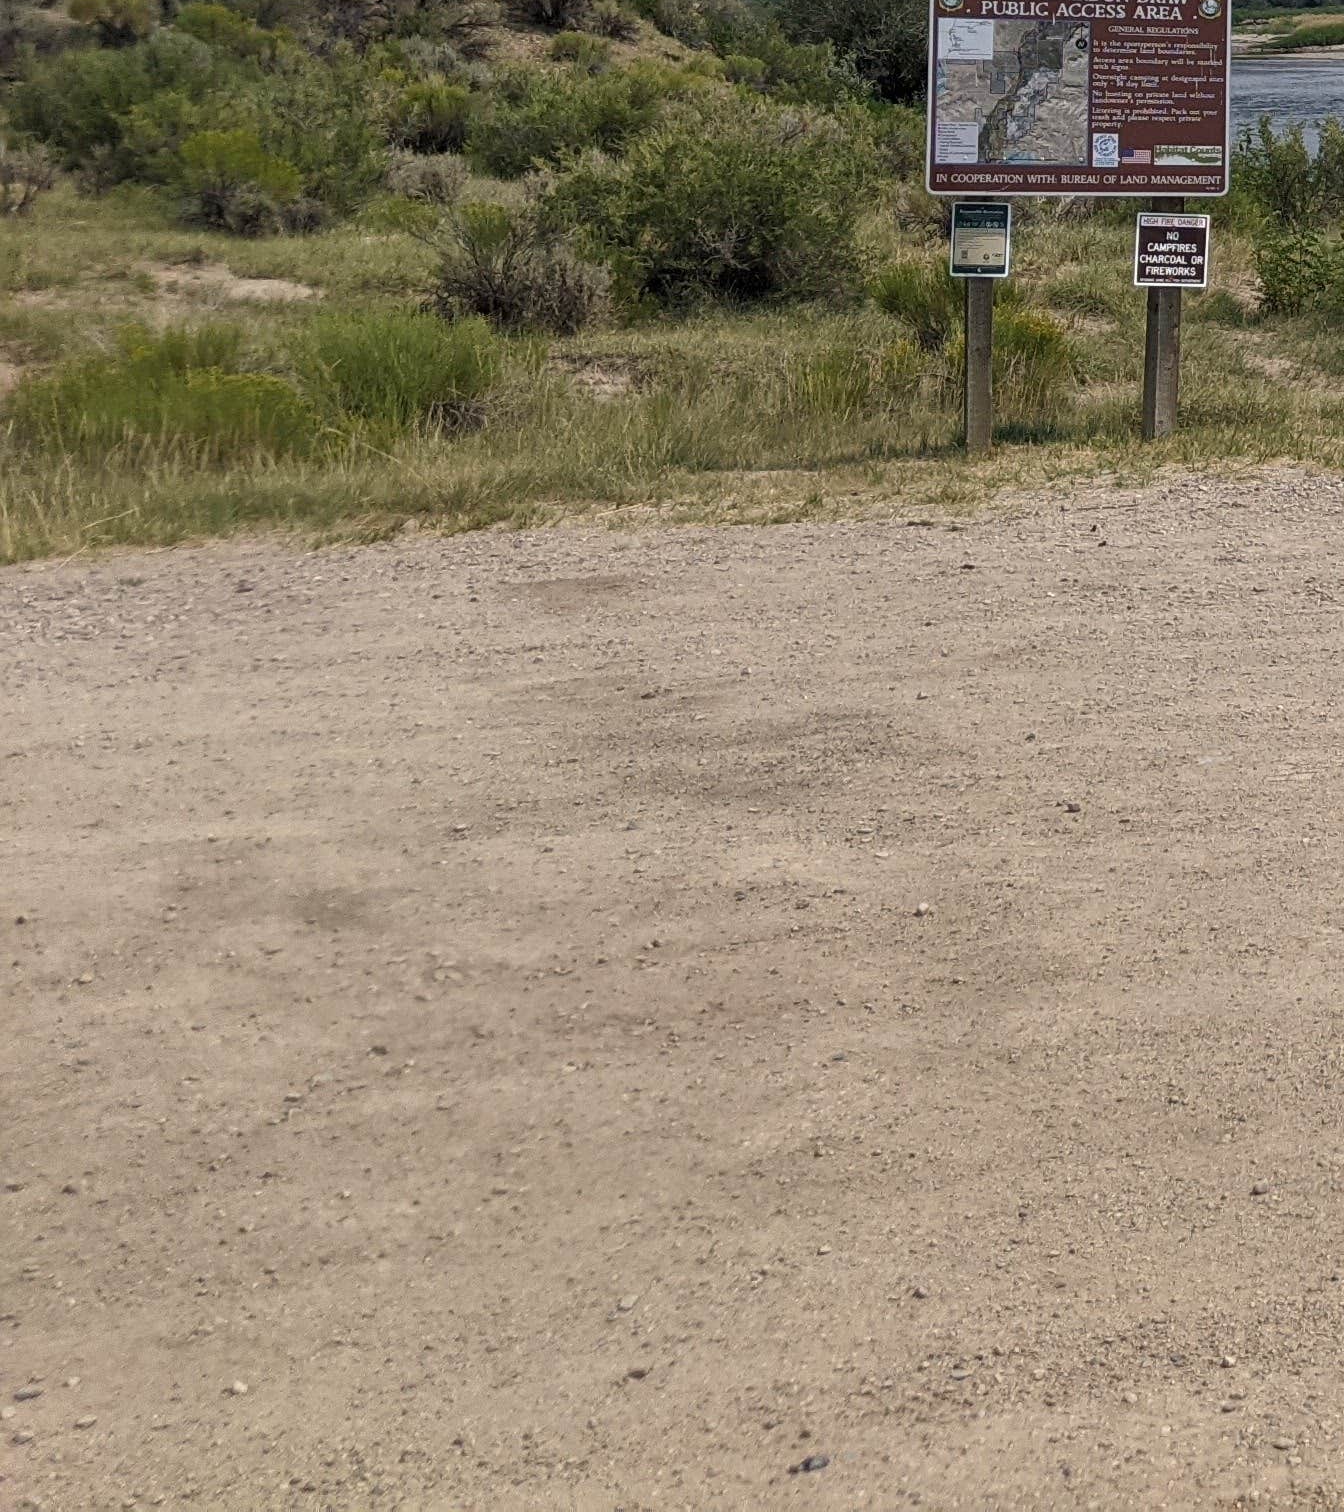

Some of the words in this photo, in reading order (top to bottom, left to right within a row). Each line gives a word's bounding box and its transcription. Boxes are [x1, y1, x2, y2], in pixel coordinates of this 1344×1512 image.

[980, 0, 1049, 15] PUBLIC
[1056, 3, 1126, 19] ACCESS
[1133, 6, 1183, 20] AREA
[1136, 57, 1168, 66] boundary
[936, 174, 948, 182] IN
[951, 174, 1023, 183] COOPERATION
[1027, 175, 1057, 184] WITH:
[1061, 175, 1100, 184] BUREAU
[1103, 175, 1117, 184] OF
[1120, 176, 1147, 184] LAND
[1151, 176, 1221, 184] MANAGEMENT
[1178, 218, 1204, 226] DANGER
[1167, 232, 1179, 240] NO
[1148, 243, 1197, 252] CAMPFIRES
[1140, 254, 1187, 264] CHARCOAL
[1191, 256, 1203, 264] OR
[1146, 266, 1196, 276] FIREWORKS
